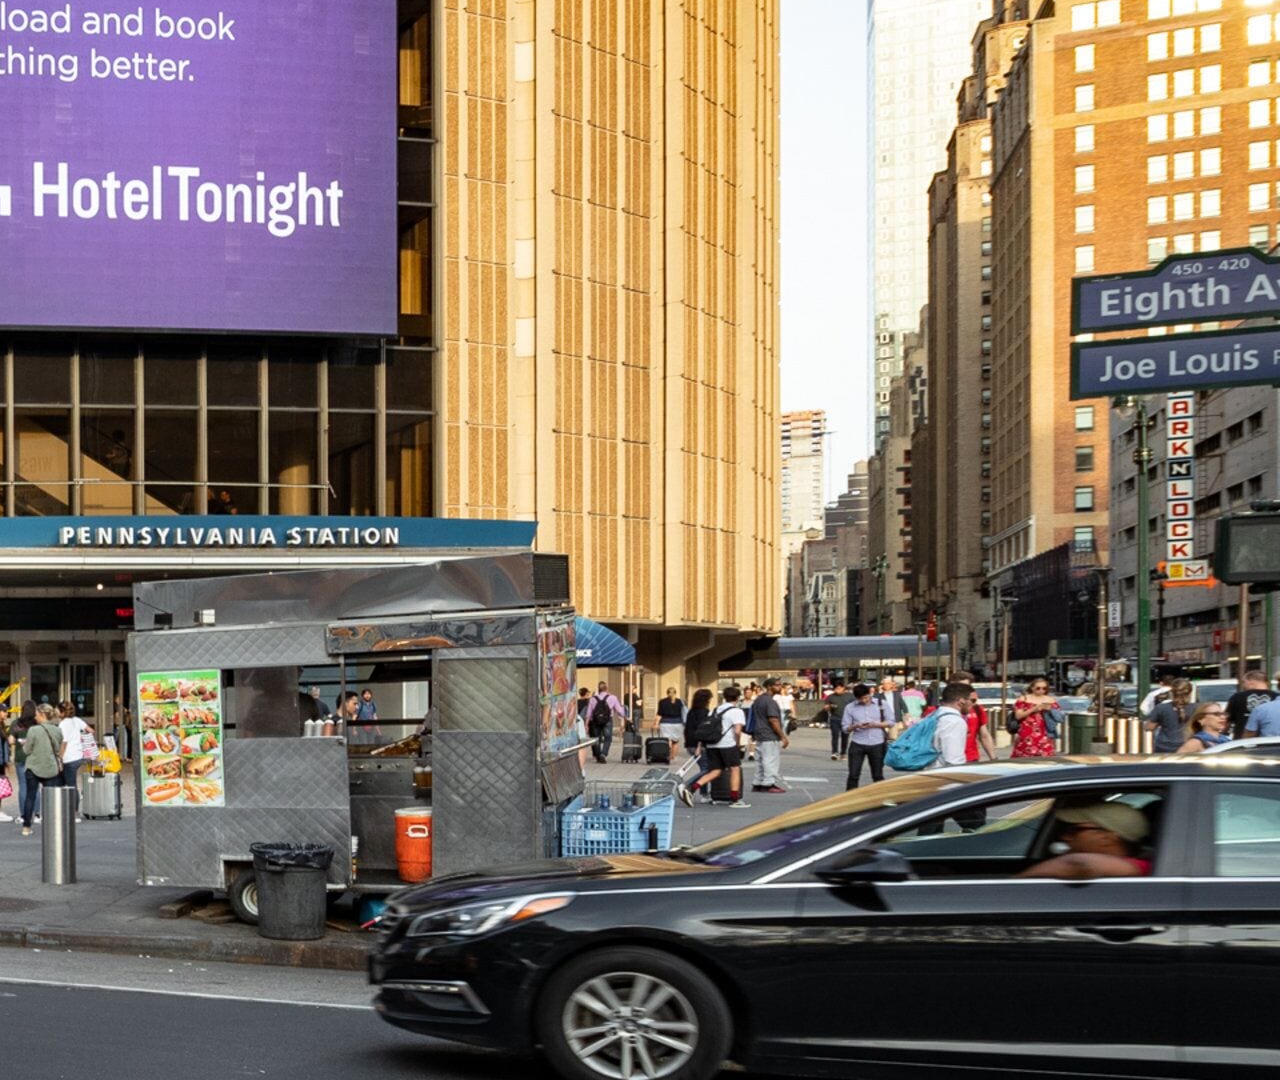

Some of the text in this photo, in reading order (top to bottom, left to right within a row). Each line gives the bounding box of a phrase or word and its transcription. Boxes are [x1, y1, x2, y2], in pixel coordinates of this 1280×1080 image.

[83, 7, 143, 36] and
[156, 8, 235, 40] book
[91, 48, 193, 81] better.
[34, 162, 343, 237] HotelTonight
[1171, 262, 1202, 276] 450
[1218, 258, 1250, 271] 420
[1100, 278, 1230, 320] Eighth
[1099, 356, 1156, 382] Joe
[1169, 343, 1259, 376] Louis
[1172, 392, 1188, 455] ARK
[61, 527, 400, 545] PENNSYLVANIA STATION
[1172, 483, 1188, 557] LOCK
[859, 659, 906, 667] FOUR PENN
